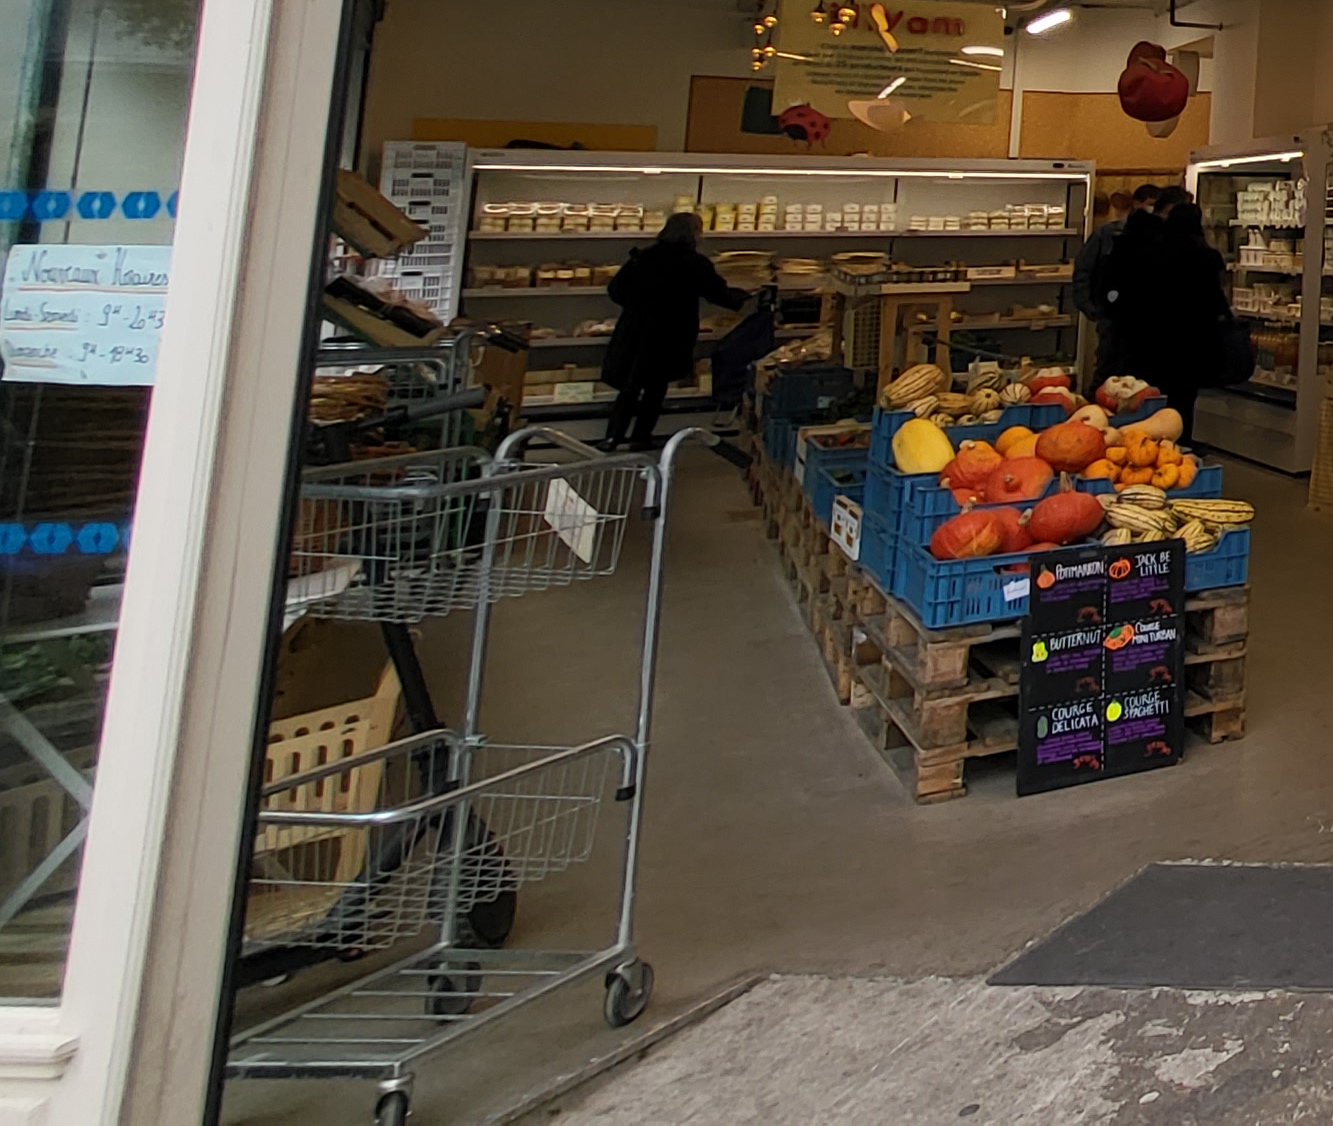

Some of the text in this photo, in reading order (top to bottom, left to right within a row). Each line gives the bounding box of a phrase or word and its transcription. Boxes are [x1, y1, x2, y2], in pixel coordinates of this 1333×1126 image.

[1135, 551, 1171, 568] JACK BE
[1140, 563, 1170, 577] LITTLE
[1050, 630, 1101, 651] BUTTERNUT
[1124, 691, 1161, 708] COURGE
[1052, 702, 1093, 721] COURGE
[1123, 700, 1169, 720] SPAGHETTI
[1052, 714, 1099, 734] DELICATA
